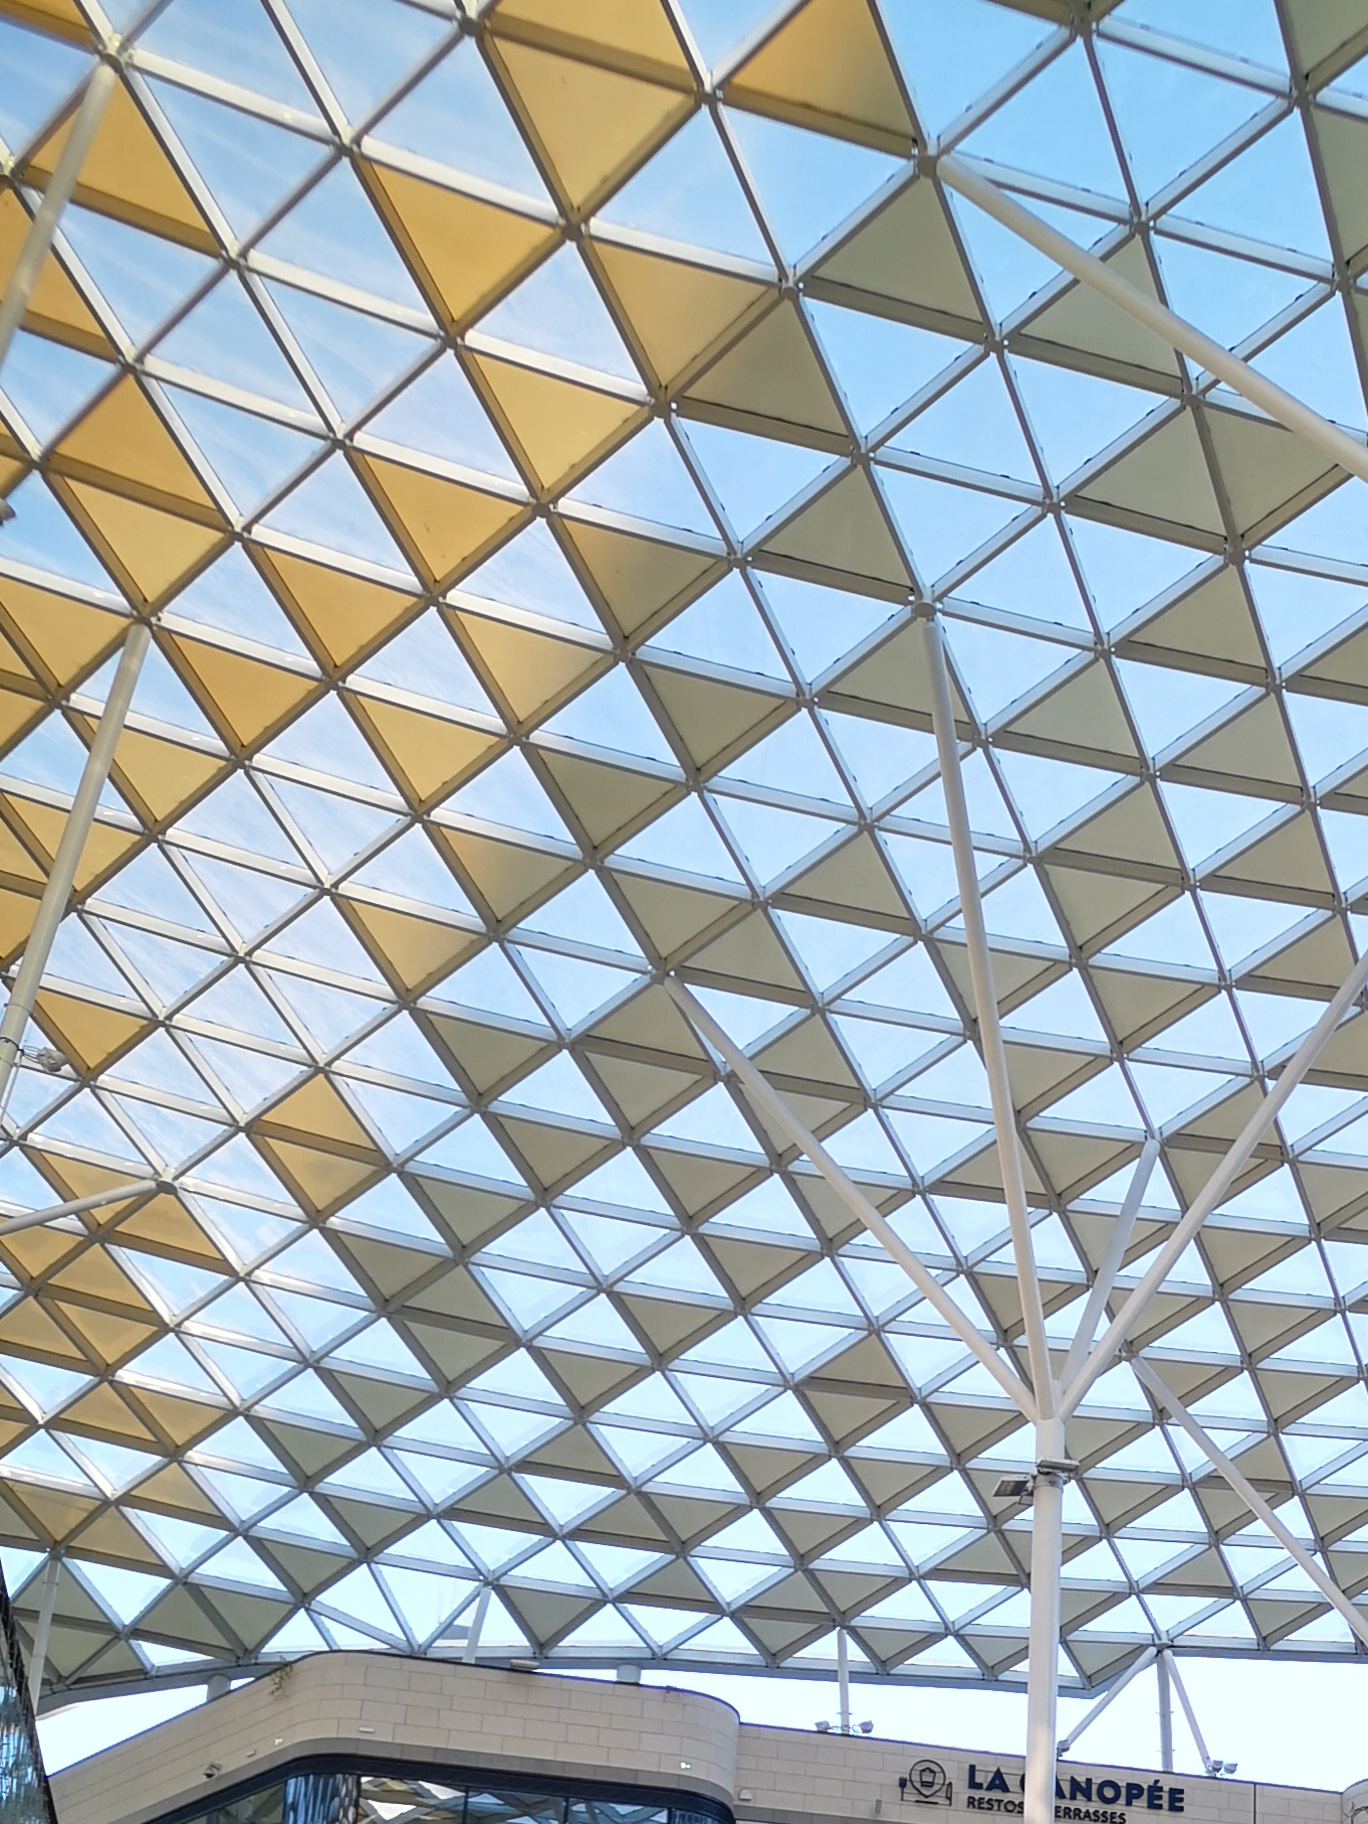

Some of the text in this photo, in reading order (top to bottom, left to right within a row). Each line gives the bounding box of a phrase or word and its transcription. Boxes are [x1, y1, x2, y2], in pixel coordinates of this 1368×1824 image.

[968, 1764, 1185, 1812] LA NOPÉE
[967, 1796, 1127, 1824] RESTOS ERRASSES
